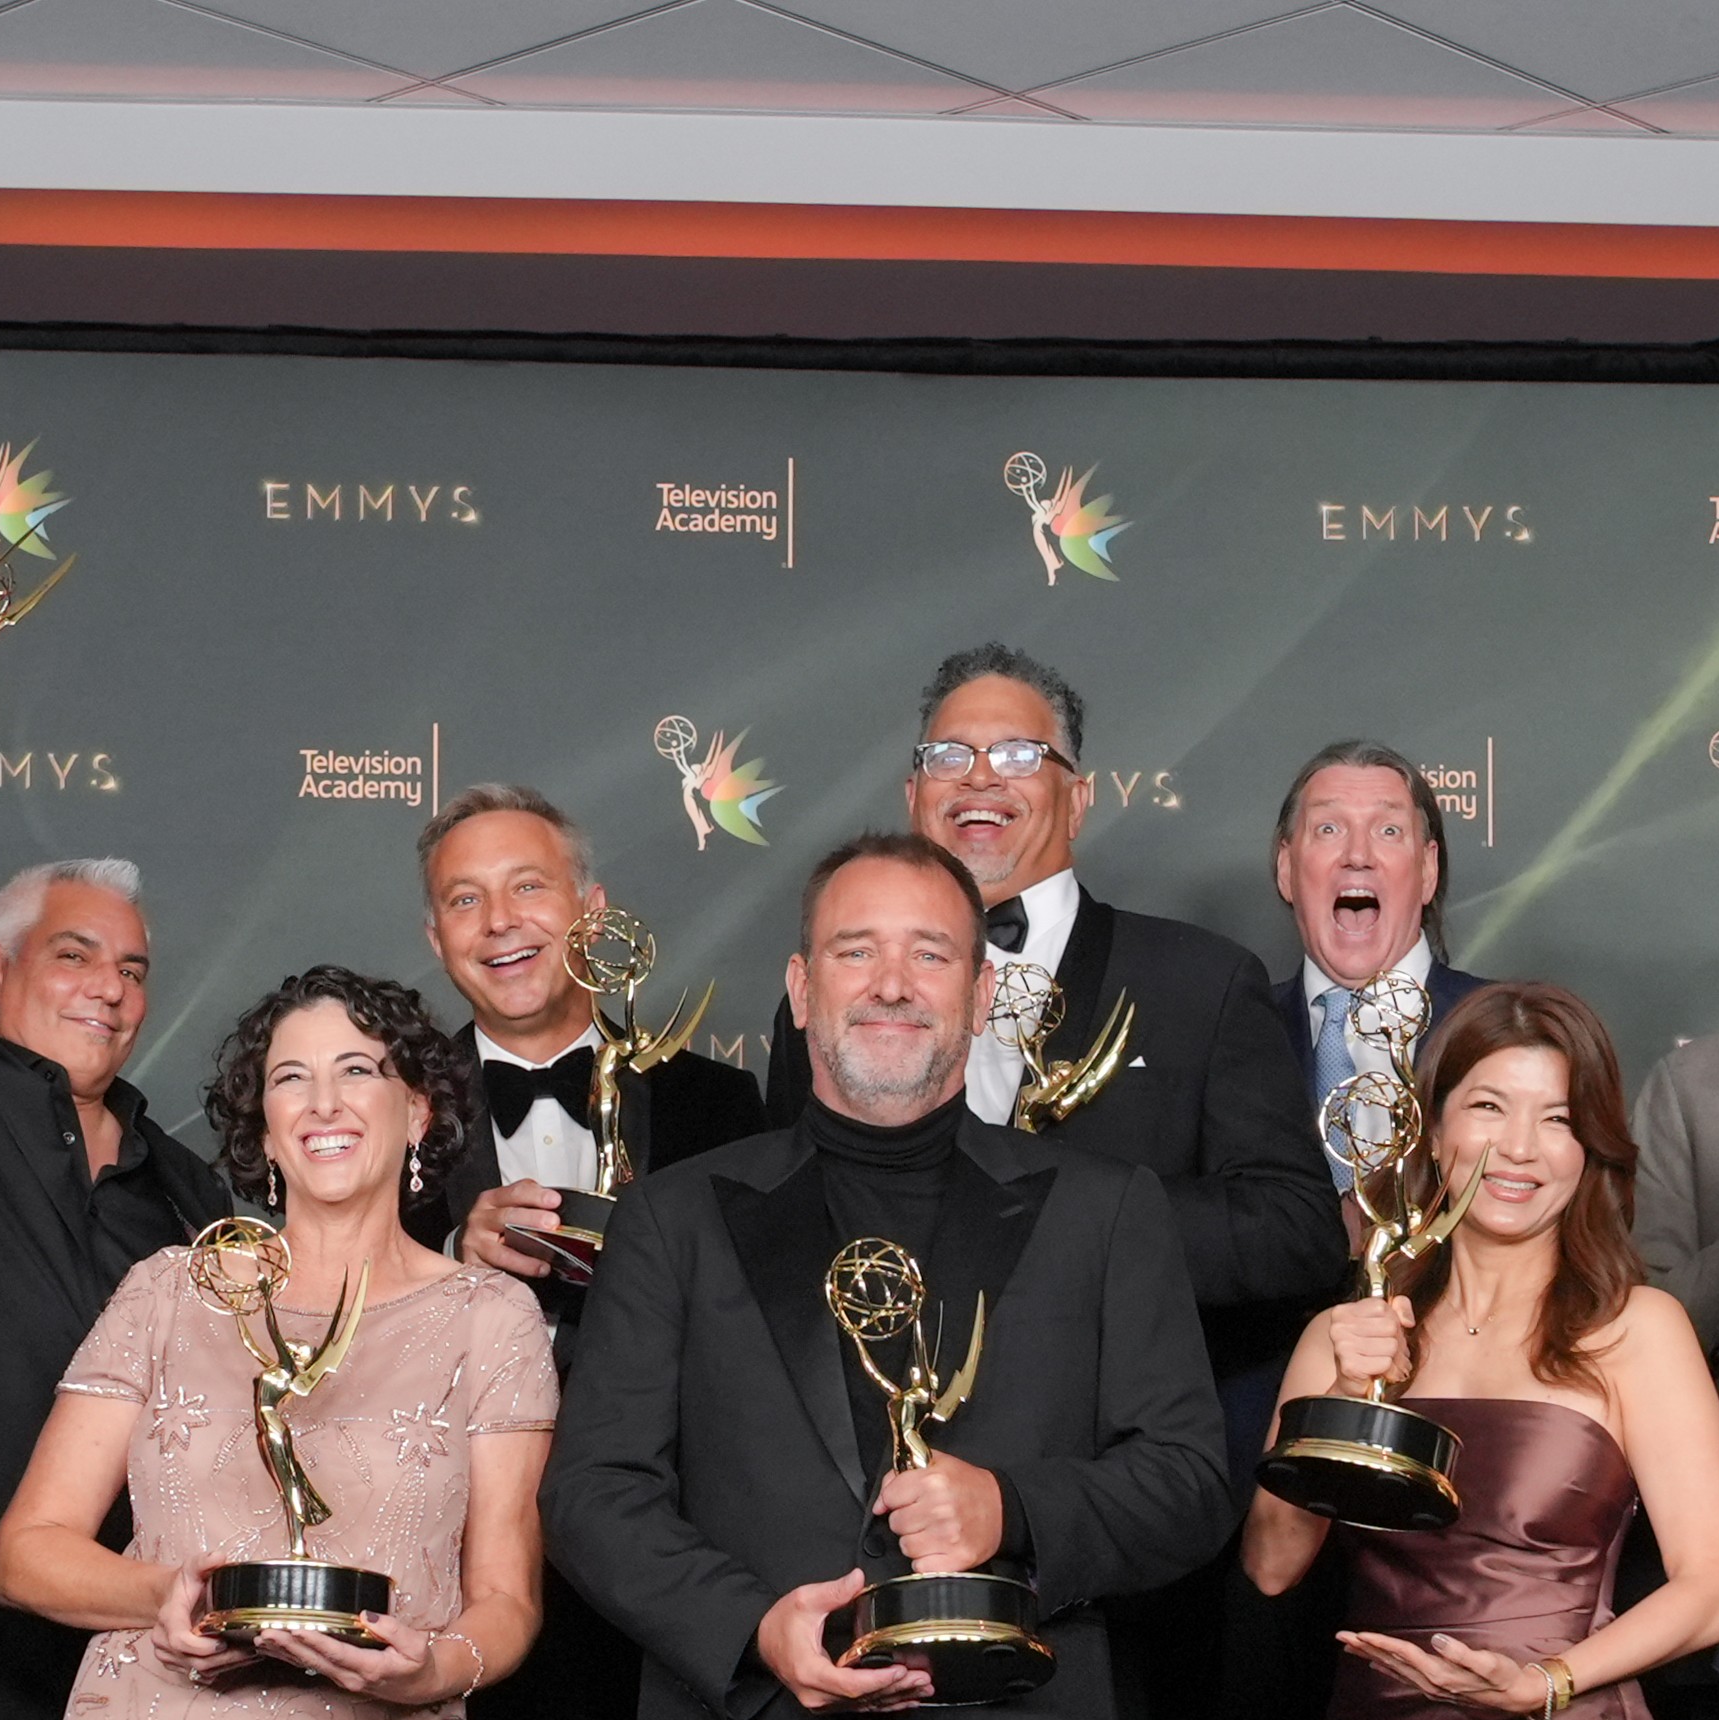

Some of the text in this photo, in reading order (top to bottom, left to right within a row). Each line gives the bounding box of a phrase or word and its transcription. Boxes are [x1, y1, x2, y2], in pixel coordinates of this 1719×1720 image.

[265, 482, 479, 523] EMMYS
[656, 483, 777, 508] Television
[656, 508, 777, 540] Academy
[1321, 504, 1533, 543] EMMYS
[300, 750, 421, 774] Television
[299, 774, 421, 806] Academy
